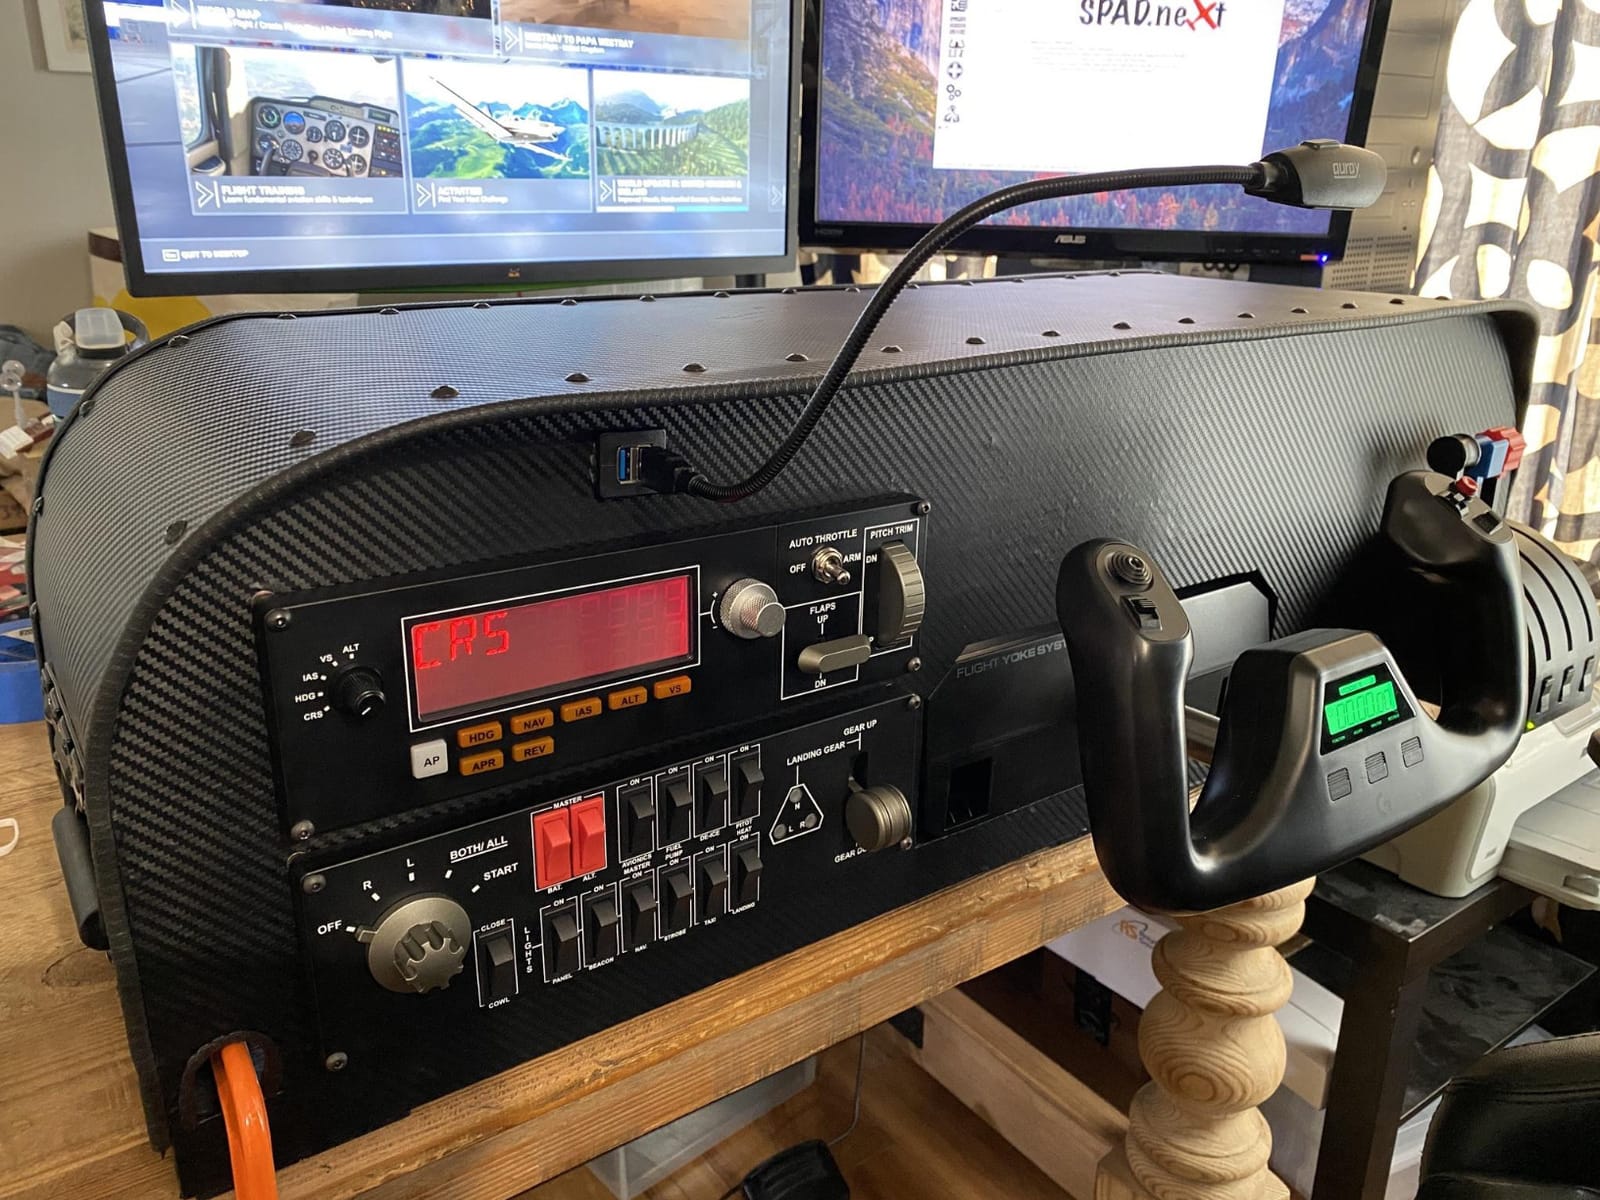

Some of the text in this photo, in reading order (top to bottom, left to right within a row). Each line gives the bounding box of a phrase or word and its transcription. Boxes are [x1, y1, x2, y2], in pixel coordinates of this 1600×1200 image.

[1080, 0, 1226, 31] SPAD.neXt
[871, 524, 913, 539] PITCH TRIM
[789, 529, 858, 549] AUTO THROTTLE
[843, 553, 862, 564] ARM
[866, 555, 877, 564] DN
[790, 563, 806, 574] OFF
[810, 603, 836, 615] FLAPS
[817, 615, 829, 624] UP
[412, 611, 510, 670] CRS
[342, 643, 360, 654] ALT
[320, 654, 333, 663] VS
[957, 658, 1000, 679] FLIGHT
[1002, 648, 1036, 665] YOKE
[302, 672, 319, 682] IAS
[815, 679, 827, 688] DN
[669, 685, 682, 694] VS
[295, 692, 316, 703] HDG
[621, 695, 640, 706] ALT
[304, 710, 324, 721] CRS
[575, 706, 593, 718] IAS
[523, 717, 546, 730] NAV
[844, 719, 878, 736] GEAR UP
[469, 730, 495, 744] HDG
[524, 745, 547, 758] REV
[786, 741, 846, 766] LANDING GEAR
[424, 756, 440, 767] AP
[472, 758, 496, 771] APR
[668, 767, 678, 775] ON
[630, 778, 640, 786] ON
[553, 796, 583, 810] MASTER
[800, 821, 806, 829] R
[737, 826, 753, 836] HEAT
[450, 836, 508, 861] BOTH/ ALL
[665, 850, 683, 861] PUMP
[835, 850, 856, 863] GEAR
[407, 858, 415, 868] L
[622, 854, 652, 869] AVIONICS
[669, 858, 679, 866] ON
[483, 862, 519, 881] START
[624, 861, 651, 875] MASTER
[583, 873, 597, 882] ALT.
[632, 871, 643, 879] ON
[363, 881, 373, 890] R
[594, 885, 604, 893] ON
[554, 899, 565, 907] ON
[732, 902, 756, 915] LANDING
[317, 920, 343, 936] OFF
[481, 919, 506, 932] CLOSE
[524, 926, 533, 974] LIGHTS
[589, 957, 615, 971] BEACON
[553, 974, 573, 985] PANEL
[489, 997, 511, 1009] COWL
